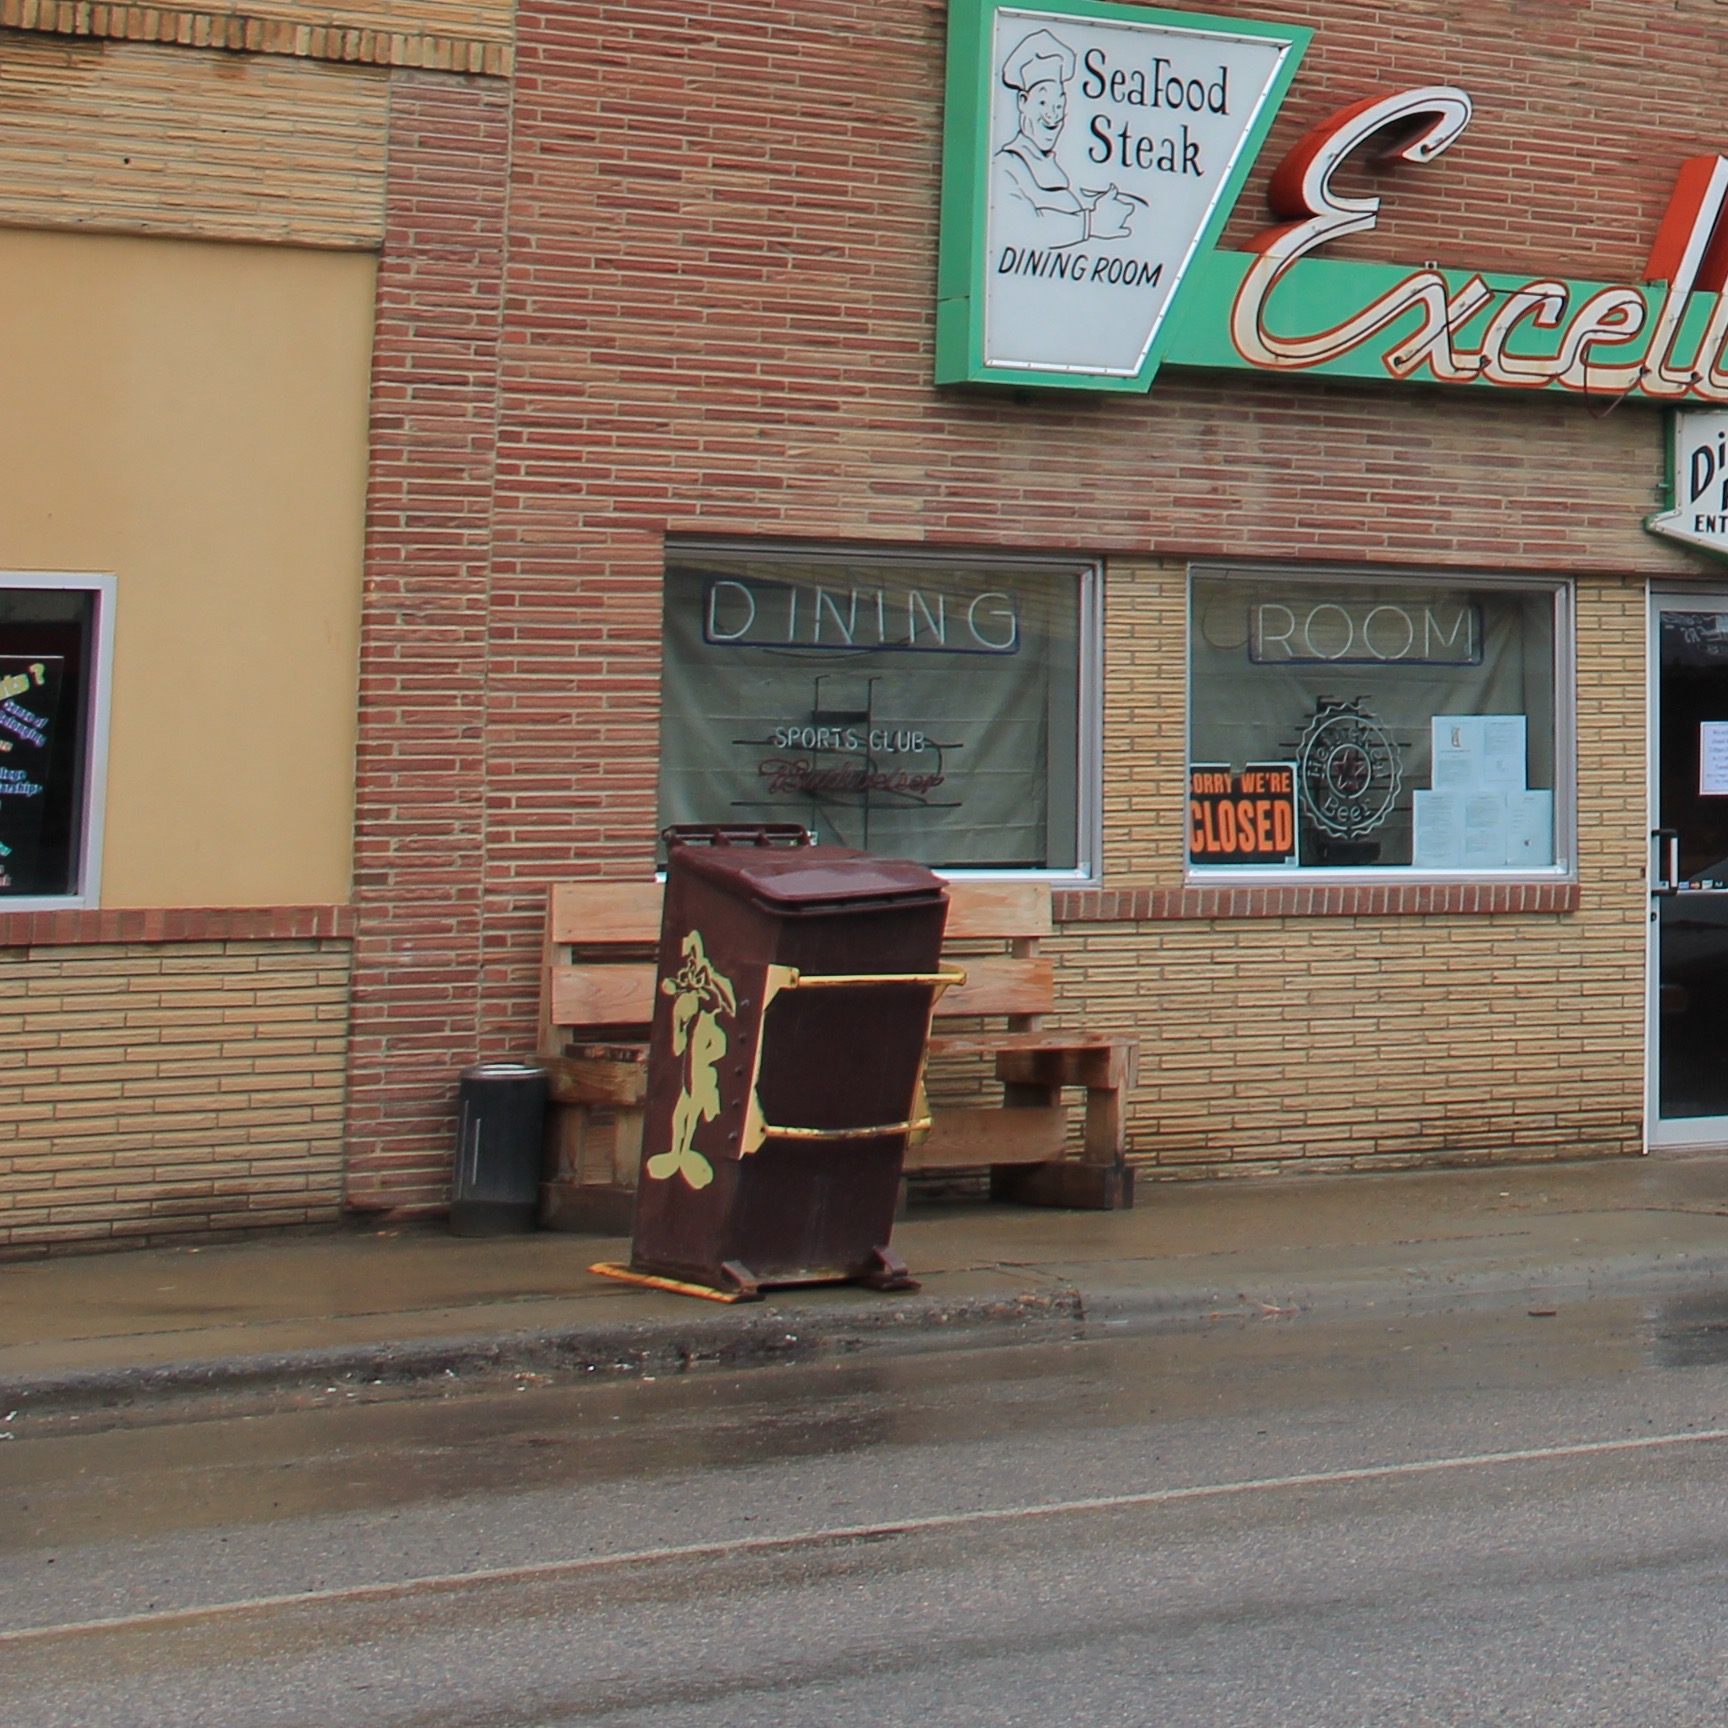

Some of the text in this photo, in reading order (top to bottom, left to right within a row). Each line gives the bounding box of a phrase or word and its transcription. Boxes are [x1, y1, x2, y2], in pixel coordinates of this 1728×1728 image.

[1088, 114, 1205, 177] Steak
[998, 245, 1163, 289] DINING ROOM
[708, 580, 1018, 650] DINING
[1257, 603, 1474, 663] ROOM
[775, 726, 926, 753] SPORTS CLUB
[1189, 773, 1291, 794] ORRY WE'RE
[1189, 799, 1293, 853] CLOSED
